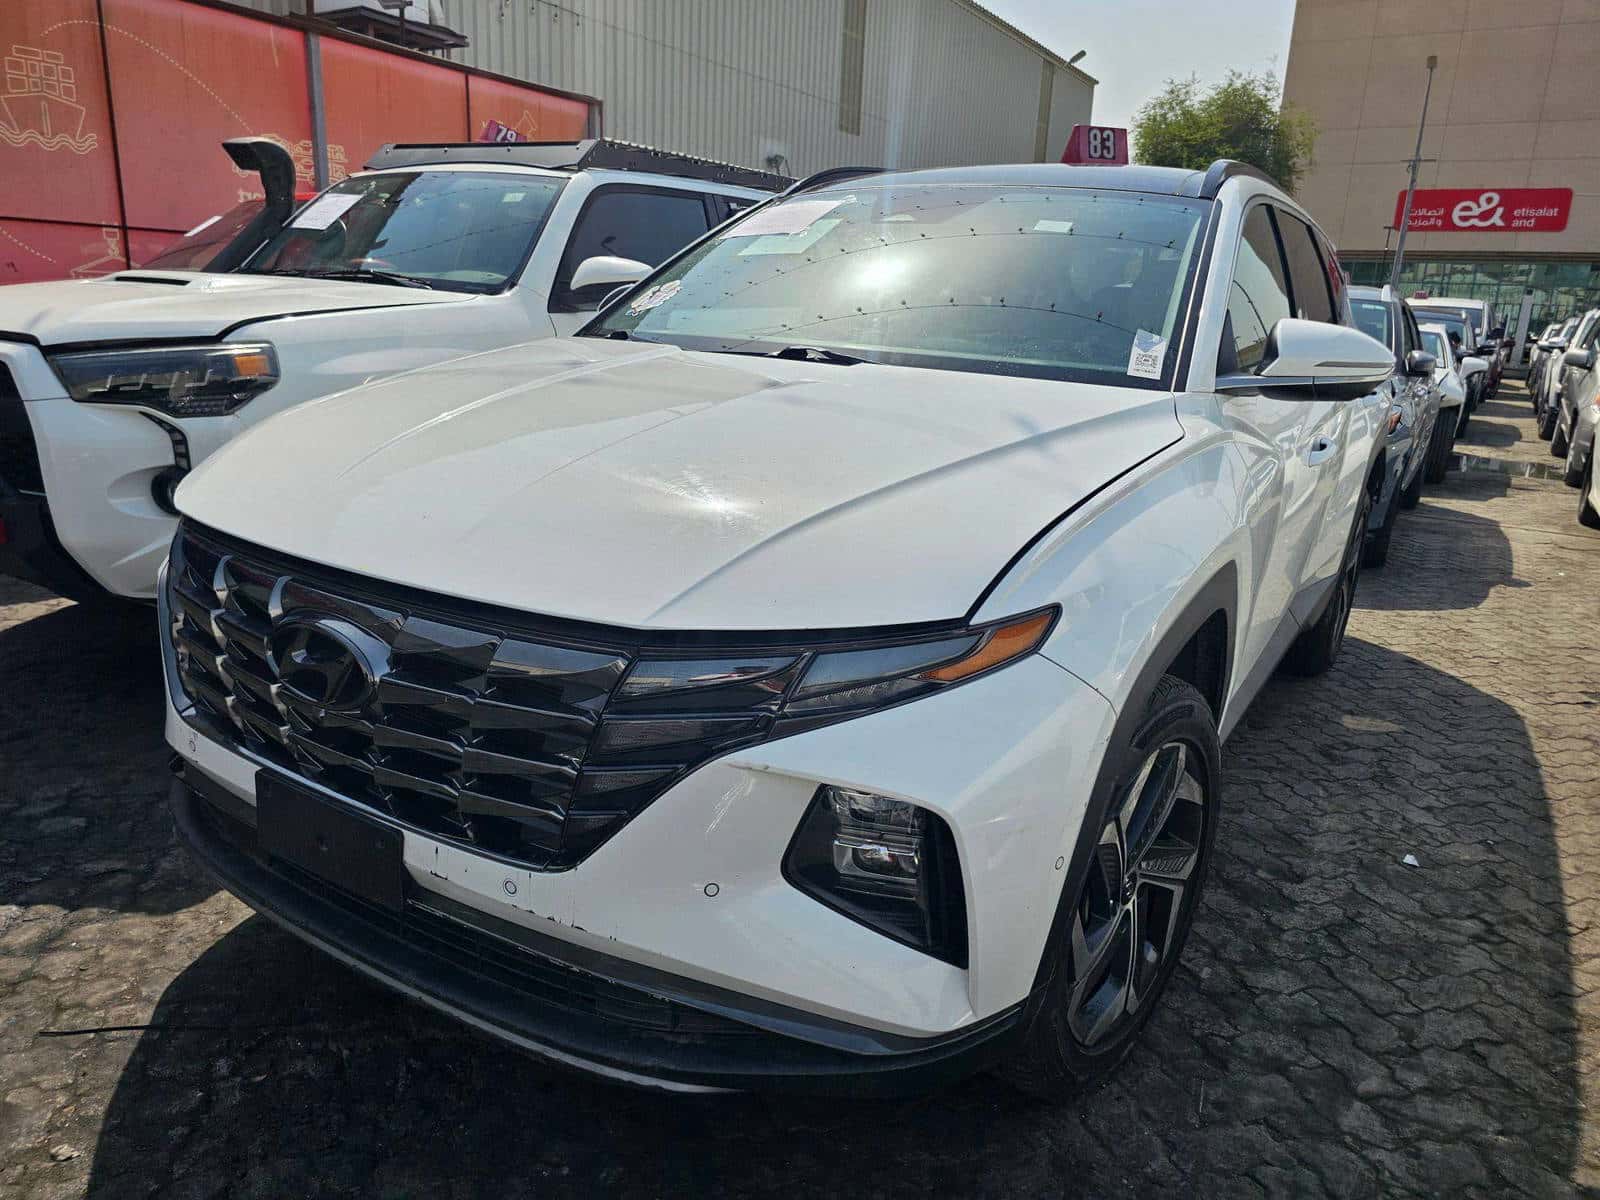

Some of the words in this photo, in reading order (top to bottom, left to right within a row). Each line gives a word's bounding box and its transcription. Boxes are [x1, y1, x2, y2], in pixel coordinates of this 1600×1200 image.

[496, 125, 518, 142] 79
[1089, 128, 1115, 159] 83
[1452, 192, 1505, 227] e&
[1513, 207, 1559, 217] etisalat
[1512, 217, 1536, 227] and
